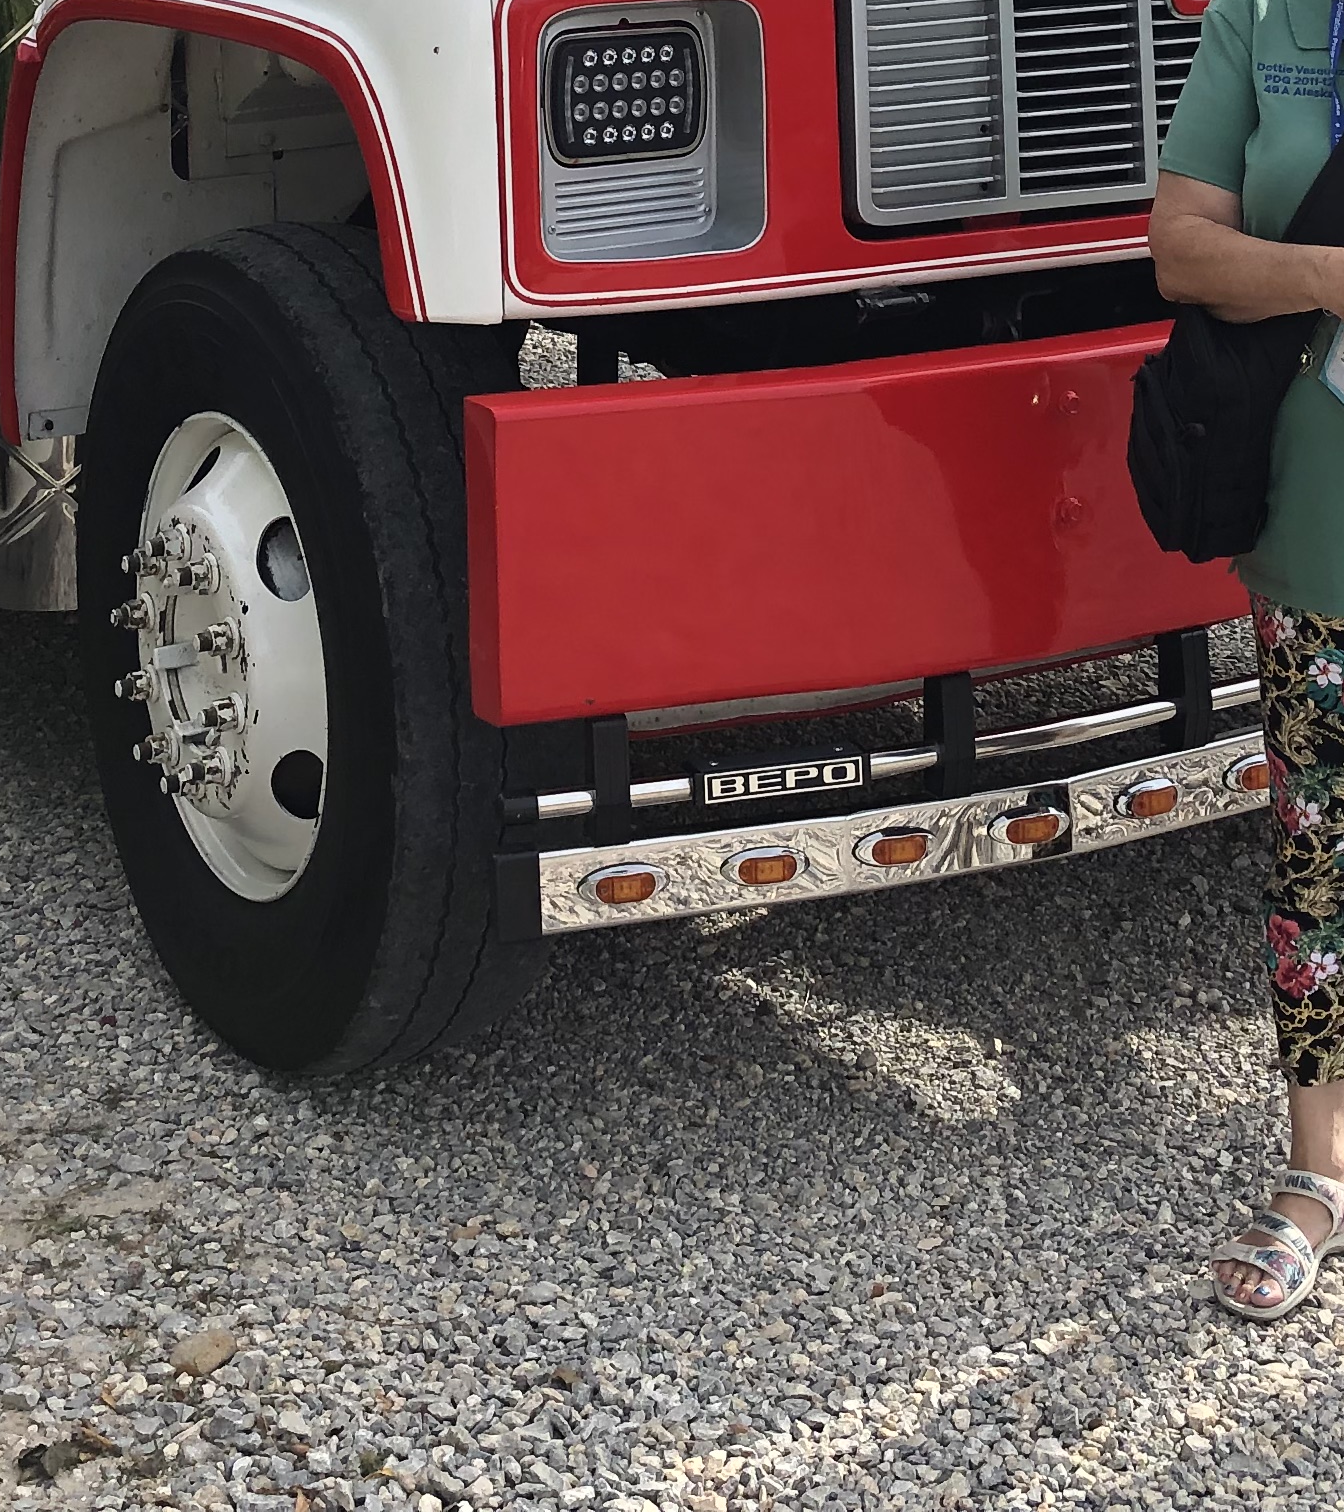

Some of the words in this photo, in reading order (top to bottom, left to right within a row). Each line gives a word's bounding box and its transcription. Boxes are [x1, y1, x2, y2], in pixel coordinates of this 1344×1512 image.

[1257, 62, 1293, 74] Dottie
[1264, 74, 1291, 85] PDG
[711, 762, 857, 798] BEPO
